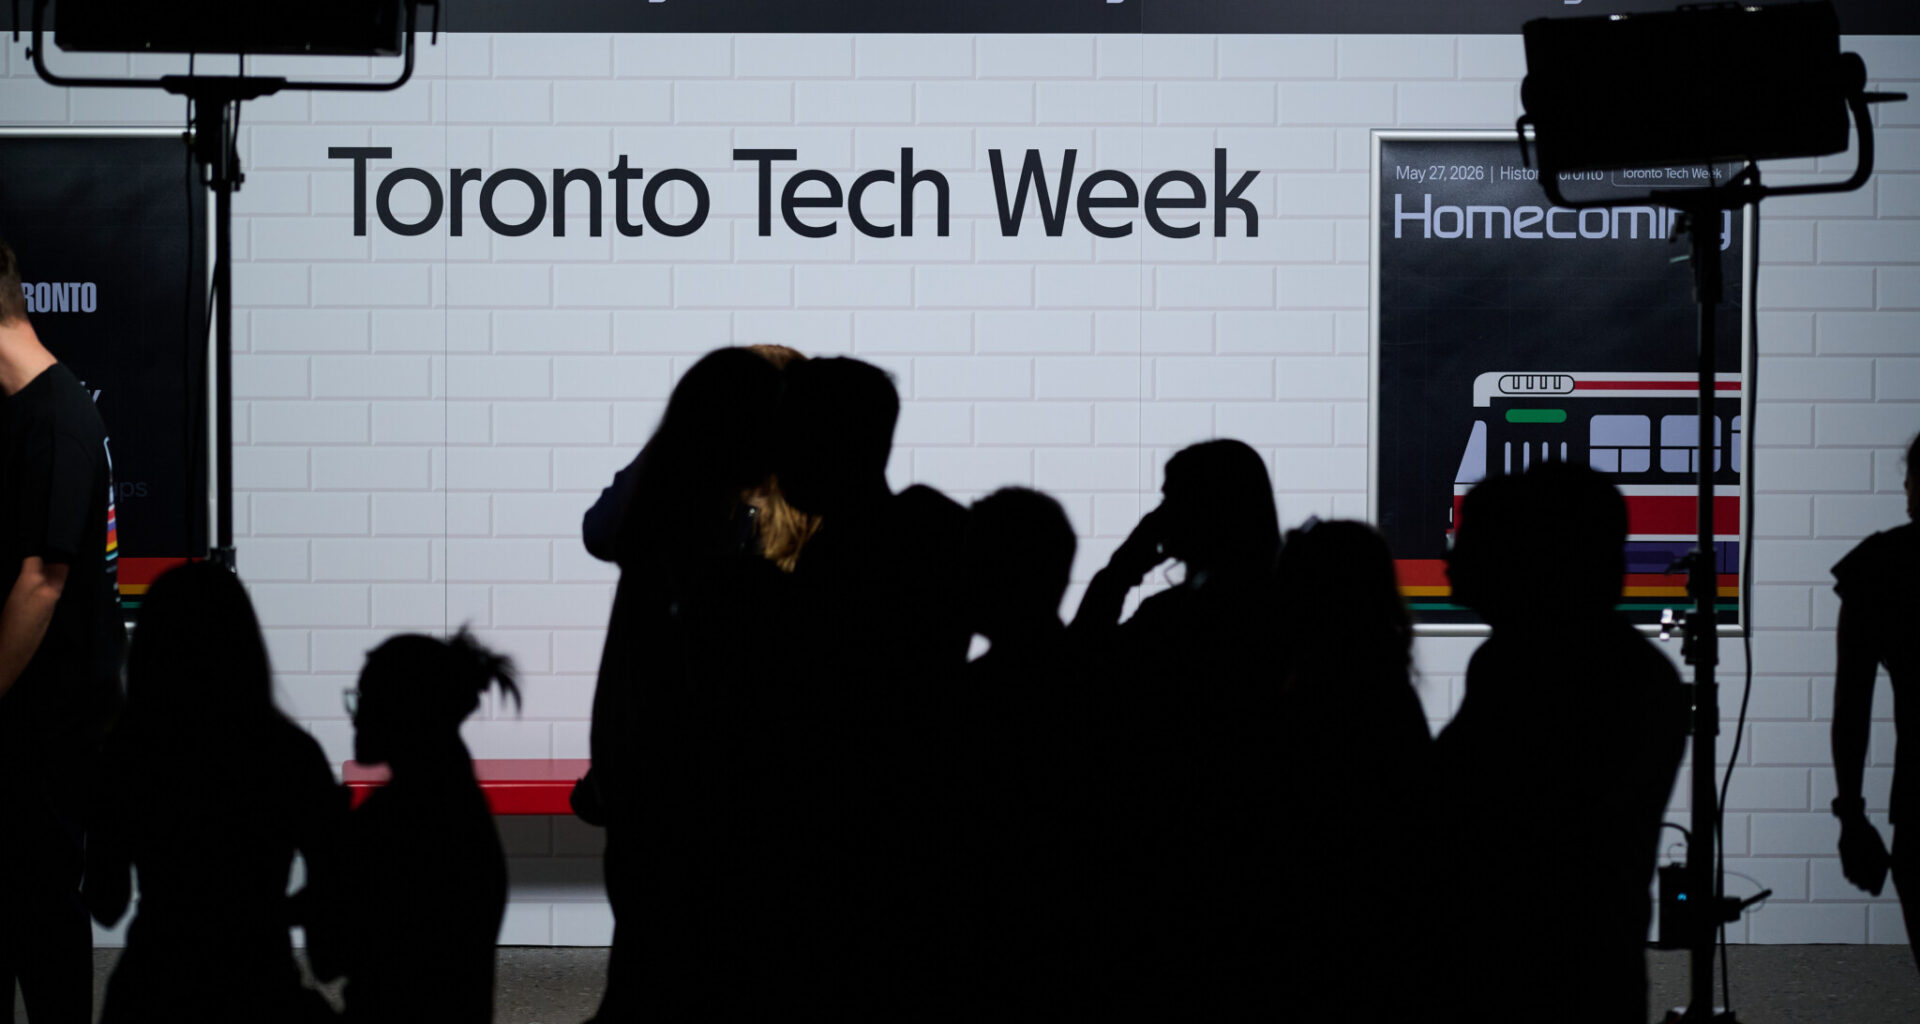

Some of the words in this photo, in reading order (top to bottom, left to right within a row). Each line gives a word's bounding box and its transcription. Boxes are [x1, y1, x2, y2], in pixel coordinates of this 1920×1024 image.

[1396, 166, 1426, 183] May
[1429, 166, 1447, 181] 27,
[1450, 166, 1484, 180] 2026
[1501, 166, 1540, 180] Histor
[1559, 169, 1604, 180] oronto
[1623, 168, 1663, 179] Toronto
[1664, 168, 1689, 179] Tech
[328, 147, 710, 237] Toronto
[733, 148, 950, 238] Tech
[988, 148, 1261, 238] Week
[21, 282, 97, 313] RONTO
